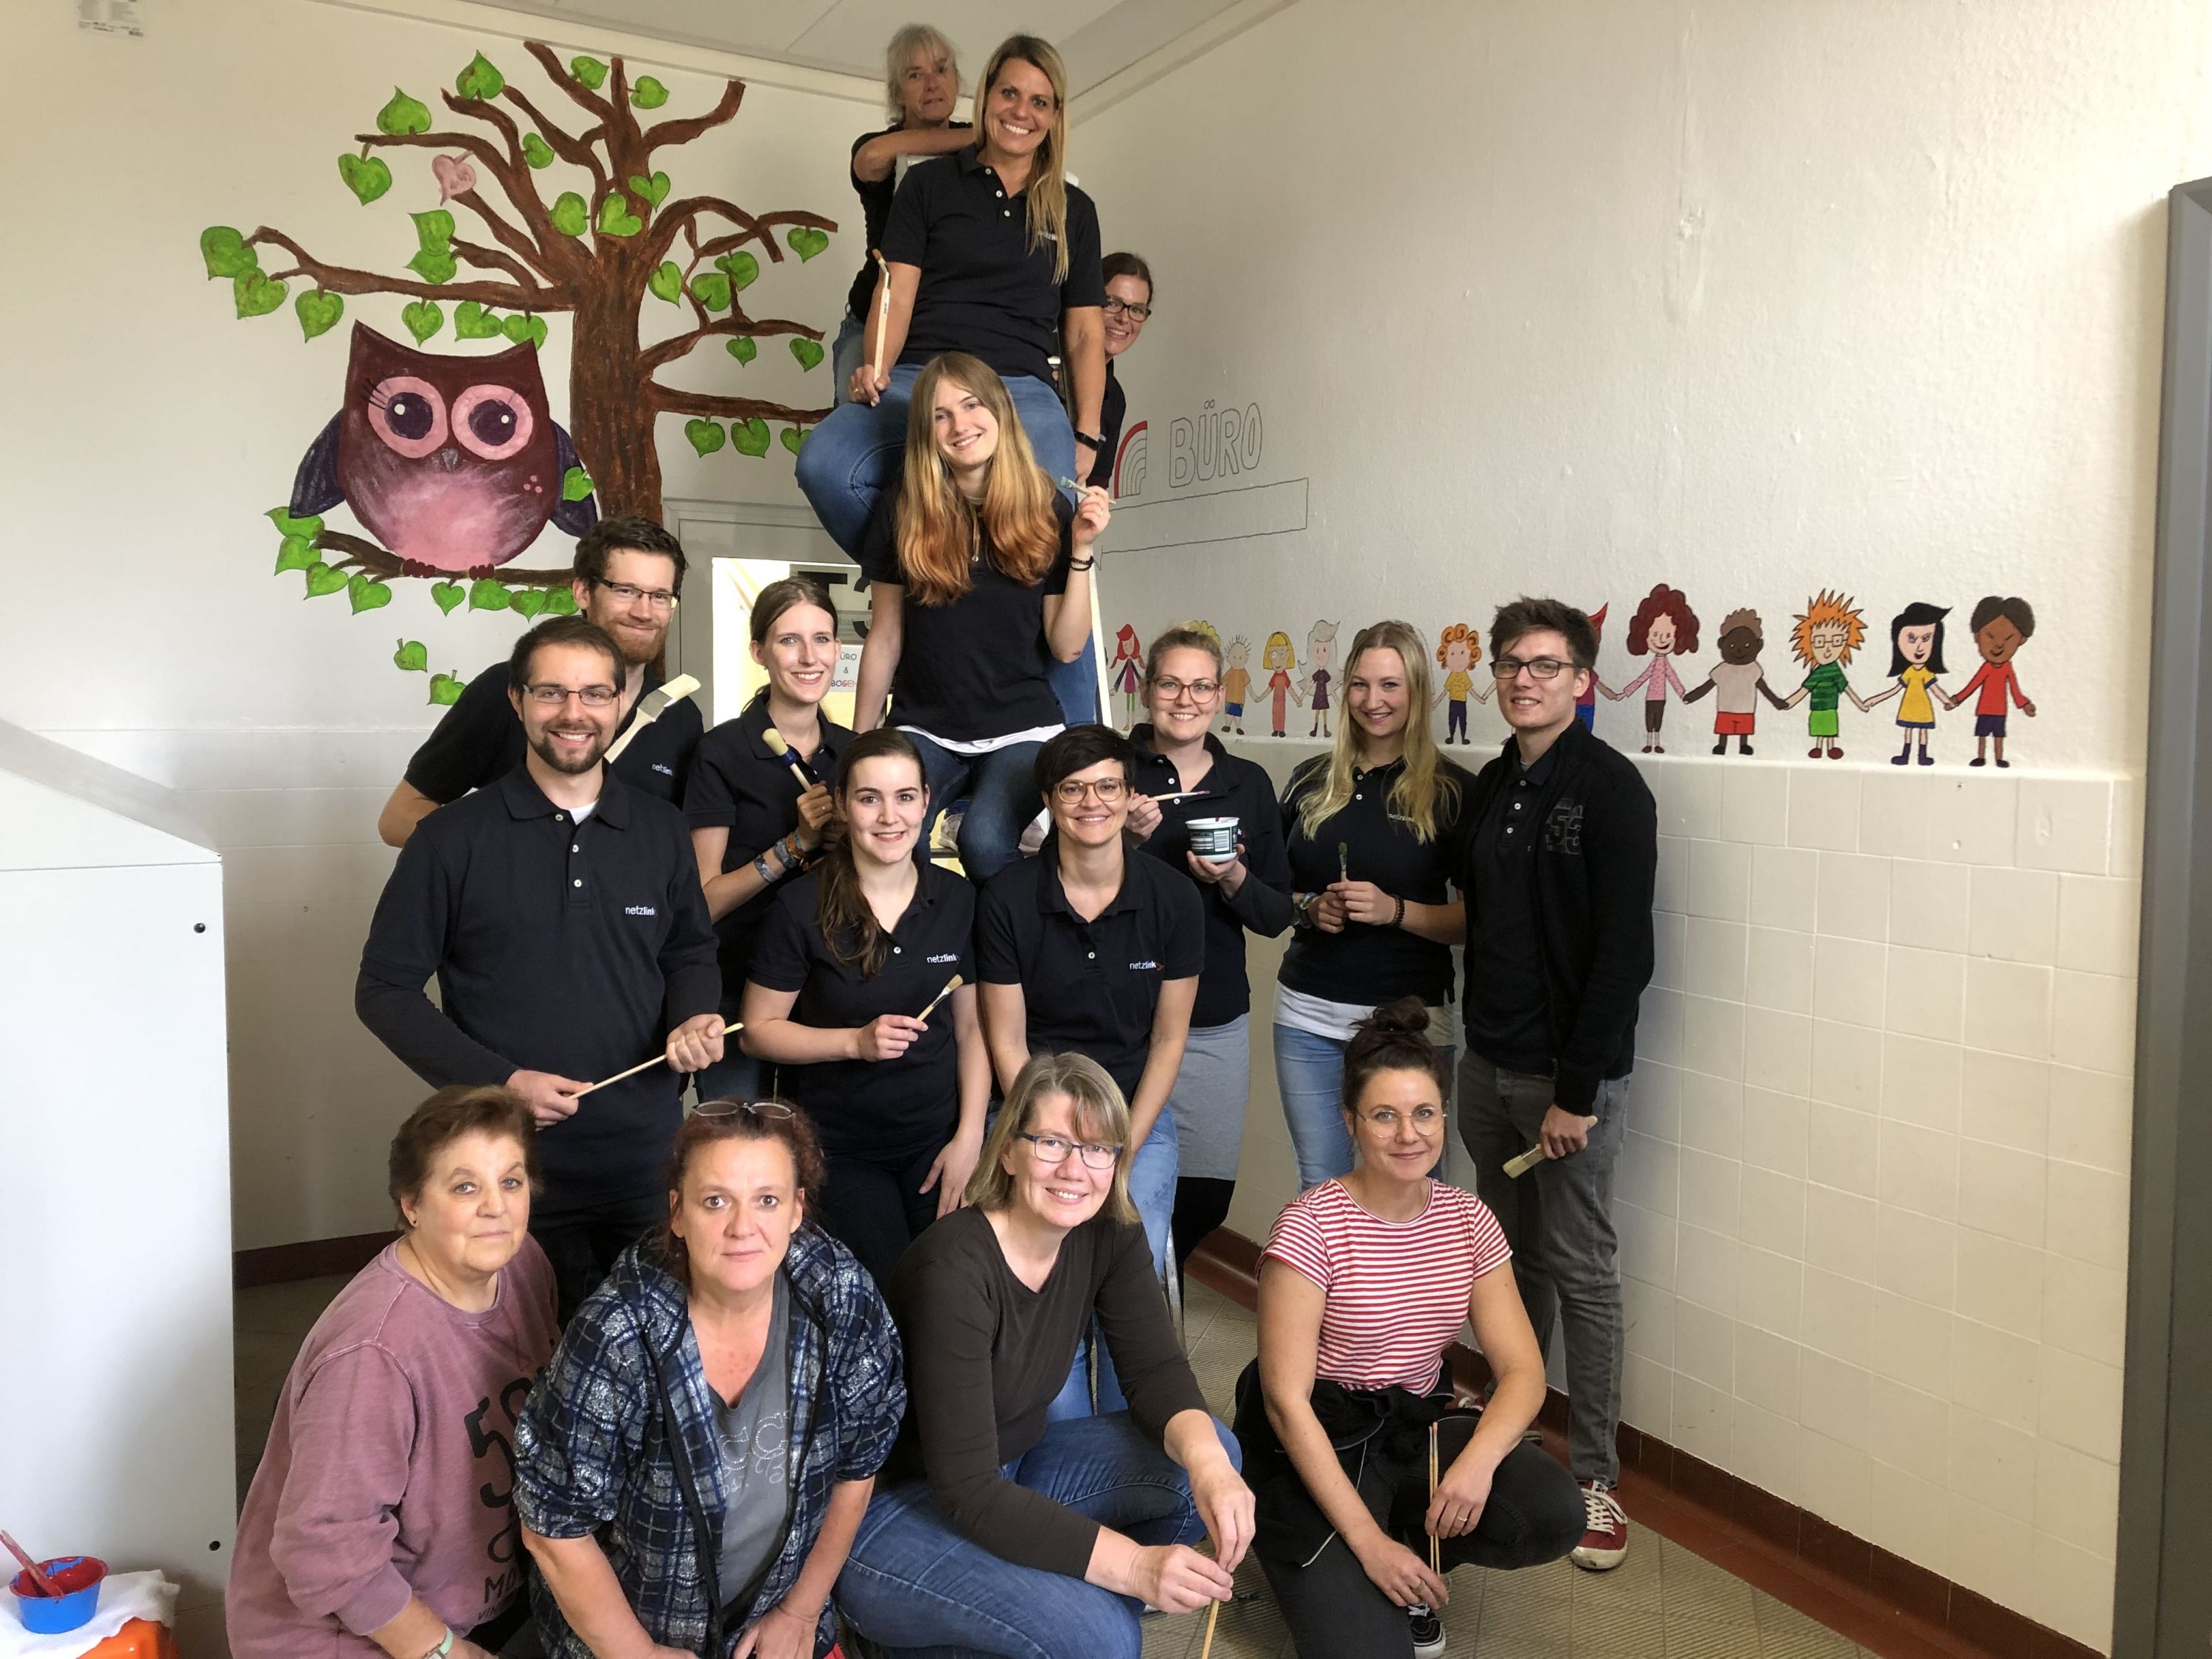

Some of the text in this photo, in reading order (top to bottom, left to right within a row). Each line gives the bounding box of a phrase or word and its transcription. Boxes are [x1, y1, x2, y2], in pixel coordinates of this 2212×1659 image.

[1169, 399, 1262, 488] BÜRO
[838, 652, 858, 661] ÜRO
[843, 666, 849, 674] &
[926, 953, 957, 964] netzlink
[1129, 960, 1157, 970] netzlink
